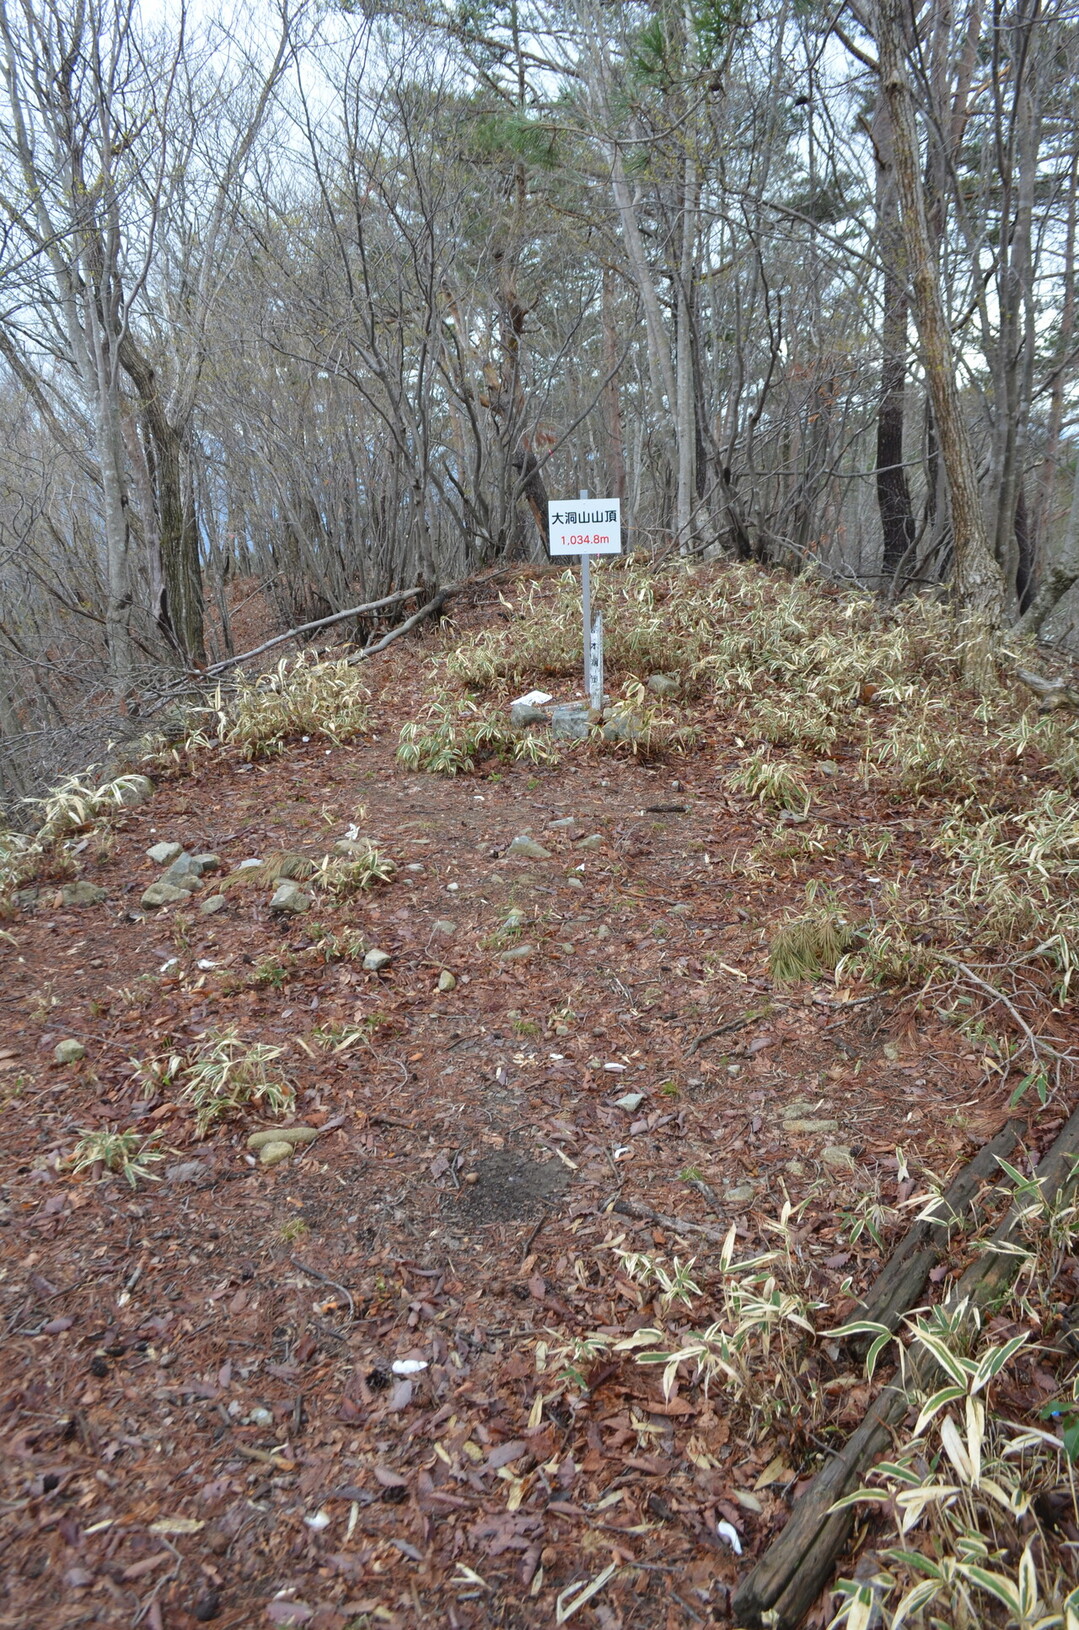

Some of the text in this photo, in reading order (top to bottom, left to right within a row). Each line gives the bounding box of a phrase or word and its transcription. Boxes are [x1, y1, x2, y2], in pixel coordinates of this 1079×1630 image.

[551, 510, 617, 525] 大洞山山頂
[561, 534, 610, 546] 1,034.8m
